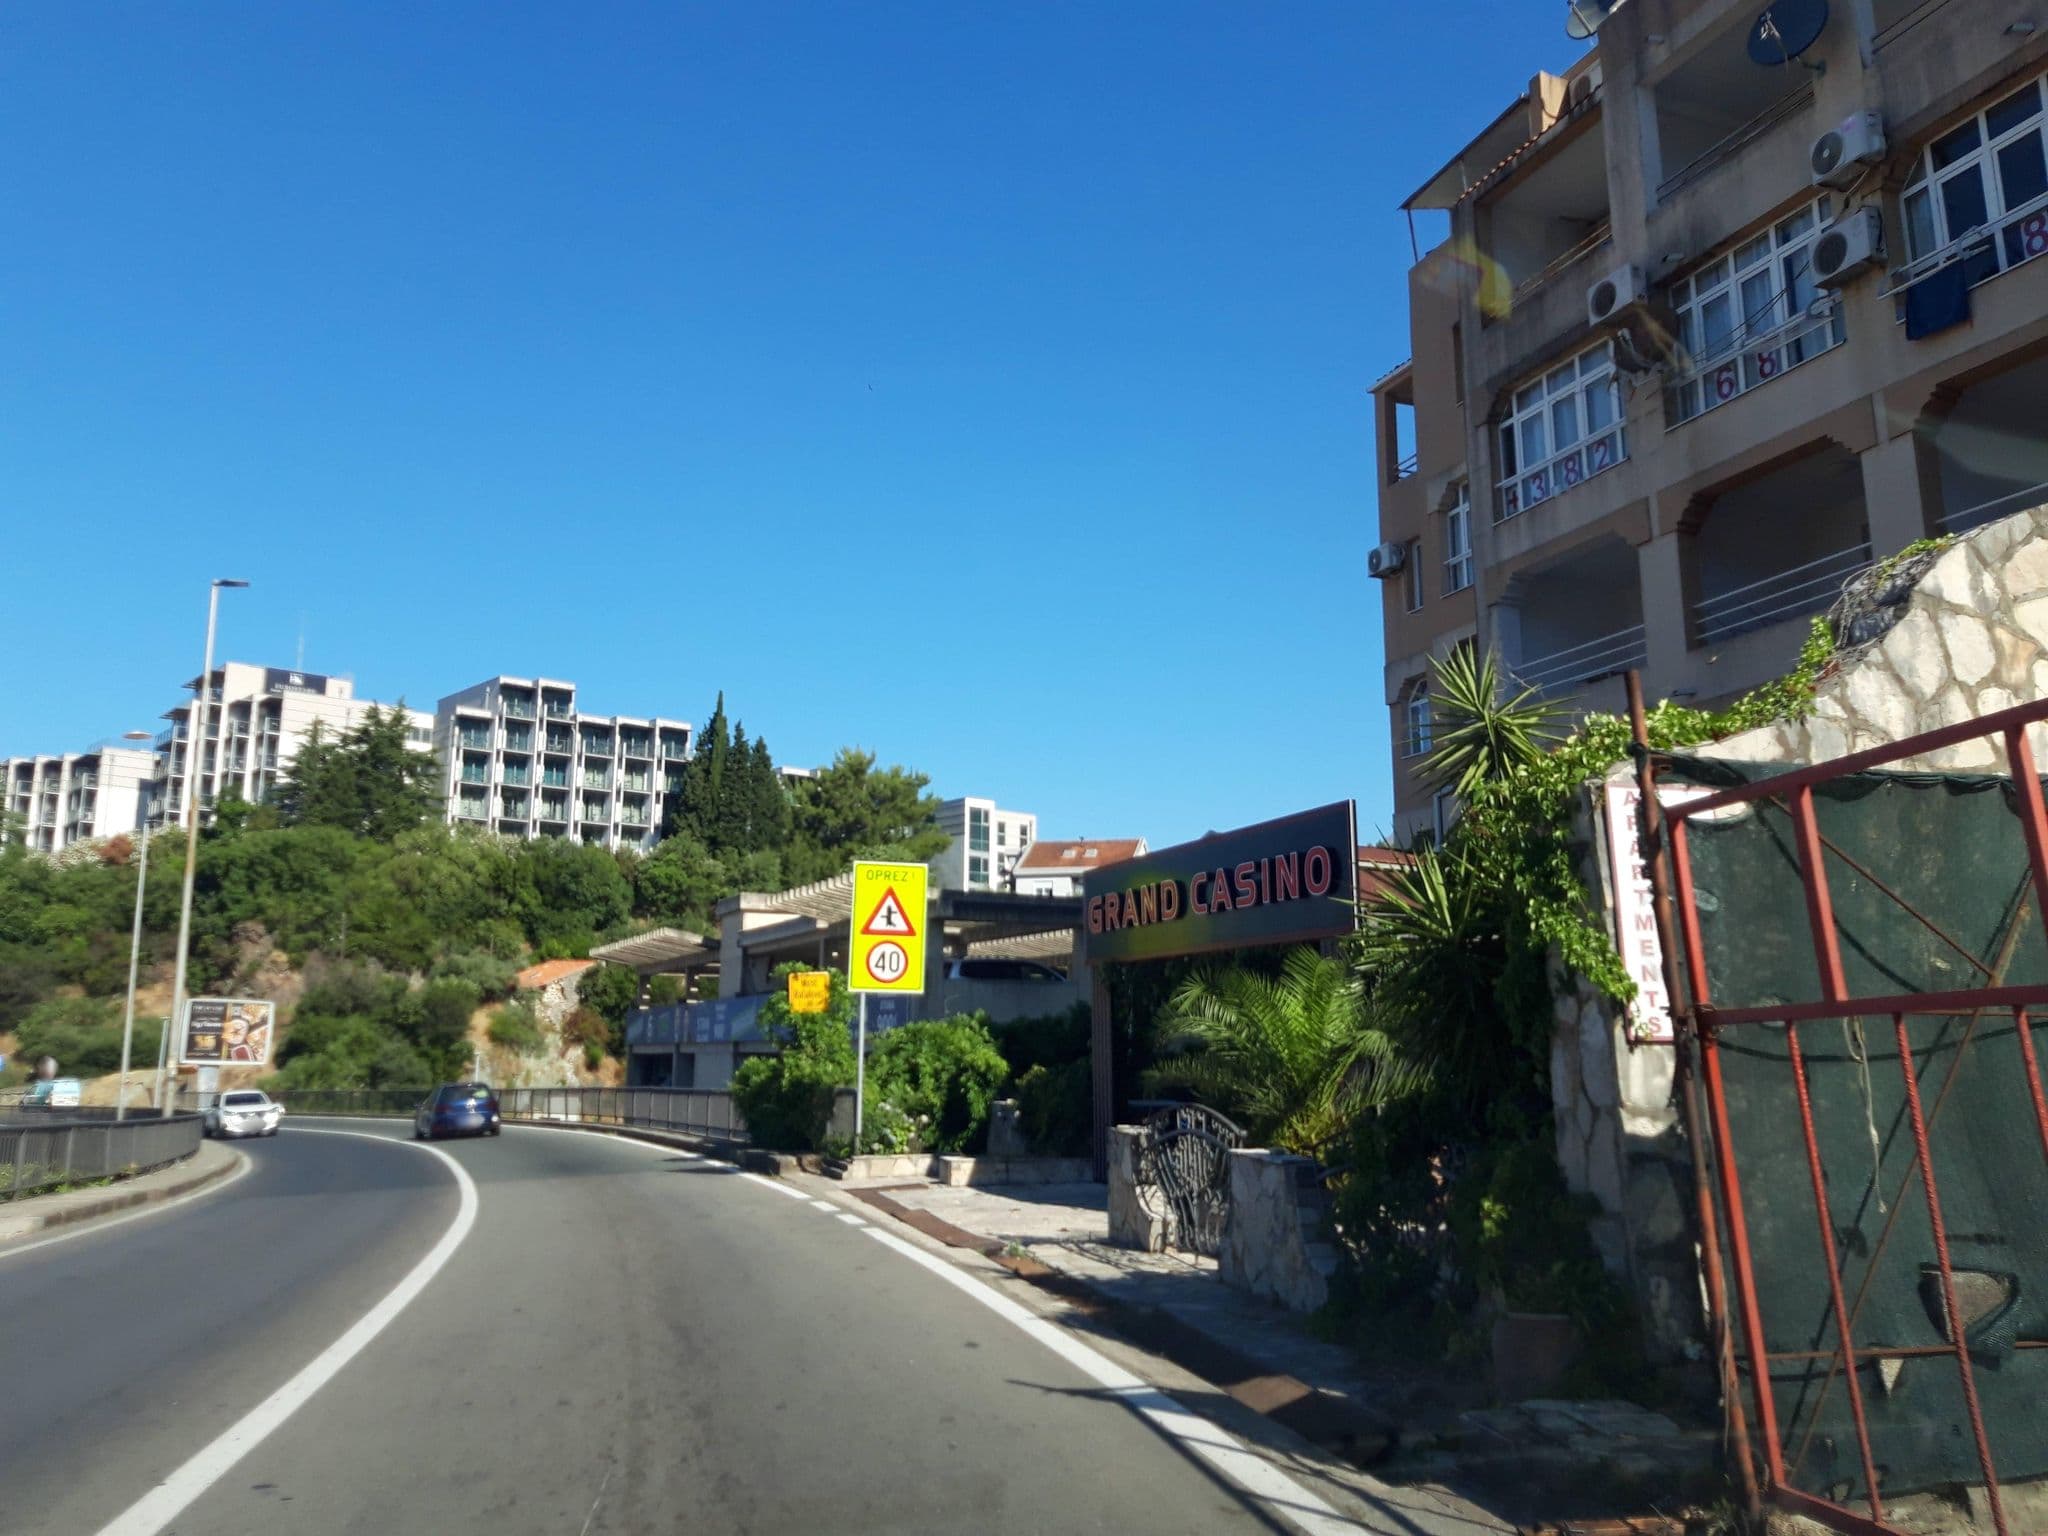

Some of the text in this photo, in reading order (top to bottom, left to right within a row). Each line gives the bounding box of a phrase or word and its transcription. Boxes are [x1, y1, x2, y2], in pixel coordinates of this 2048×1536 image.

[1088, 845, 1331, 934] GRAND CASINO
[874, 950, 900, 973] 40
